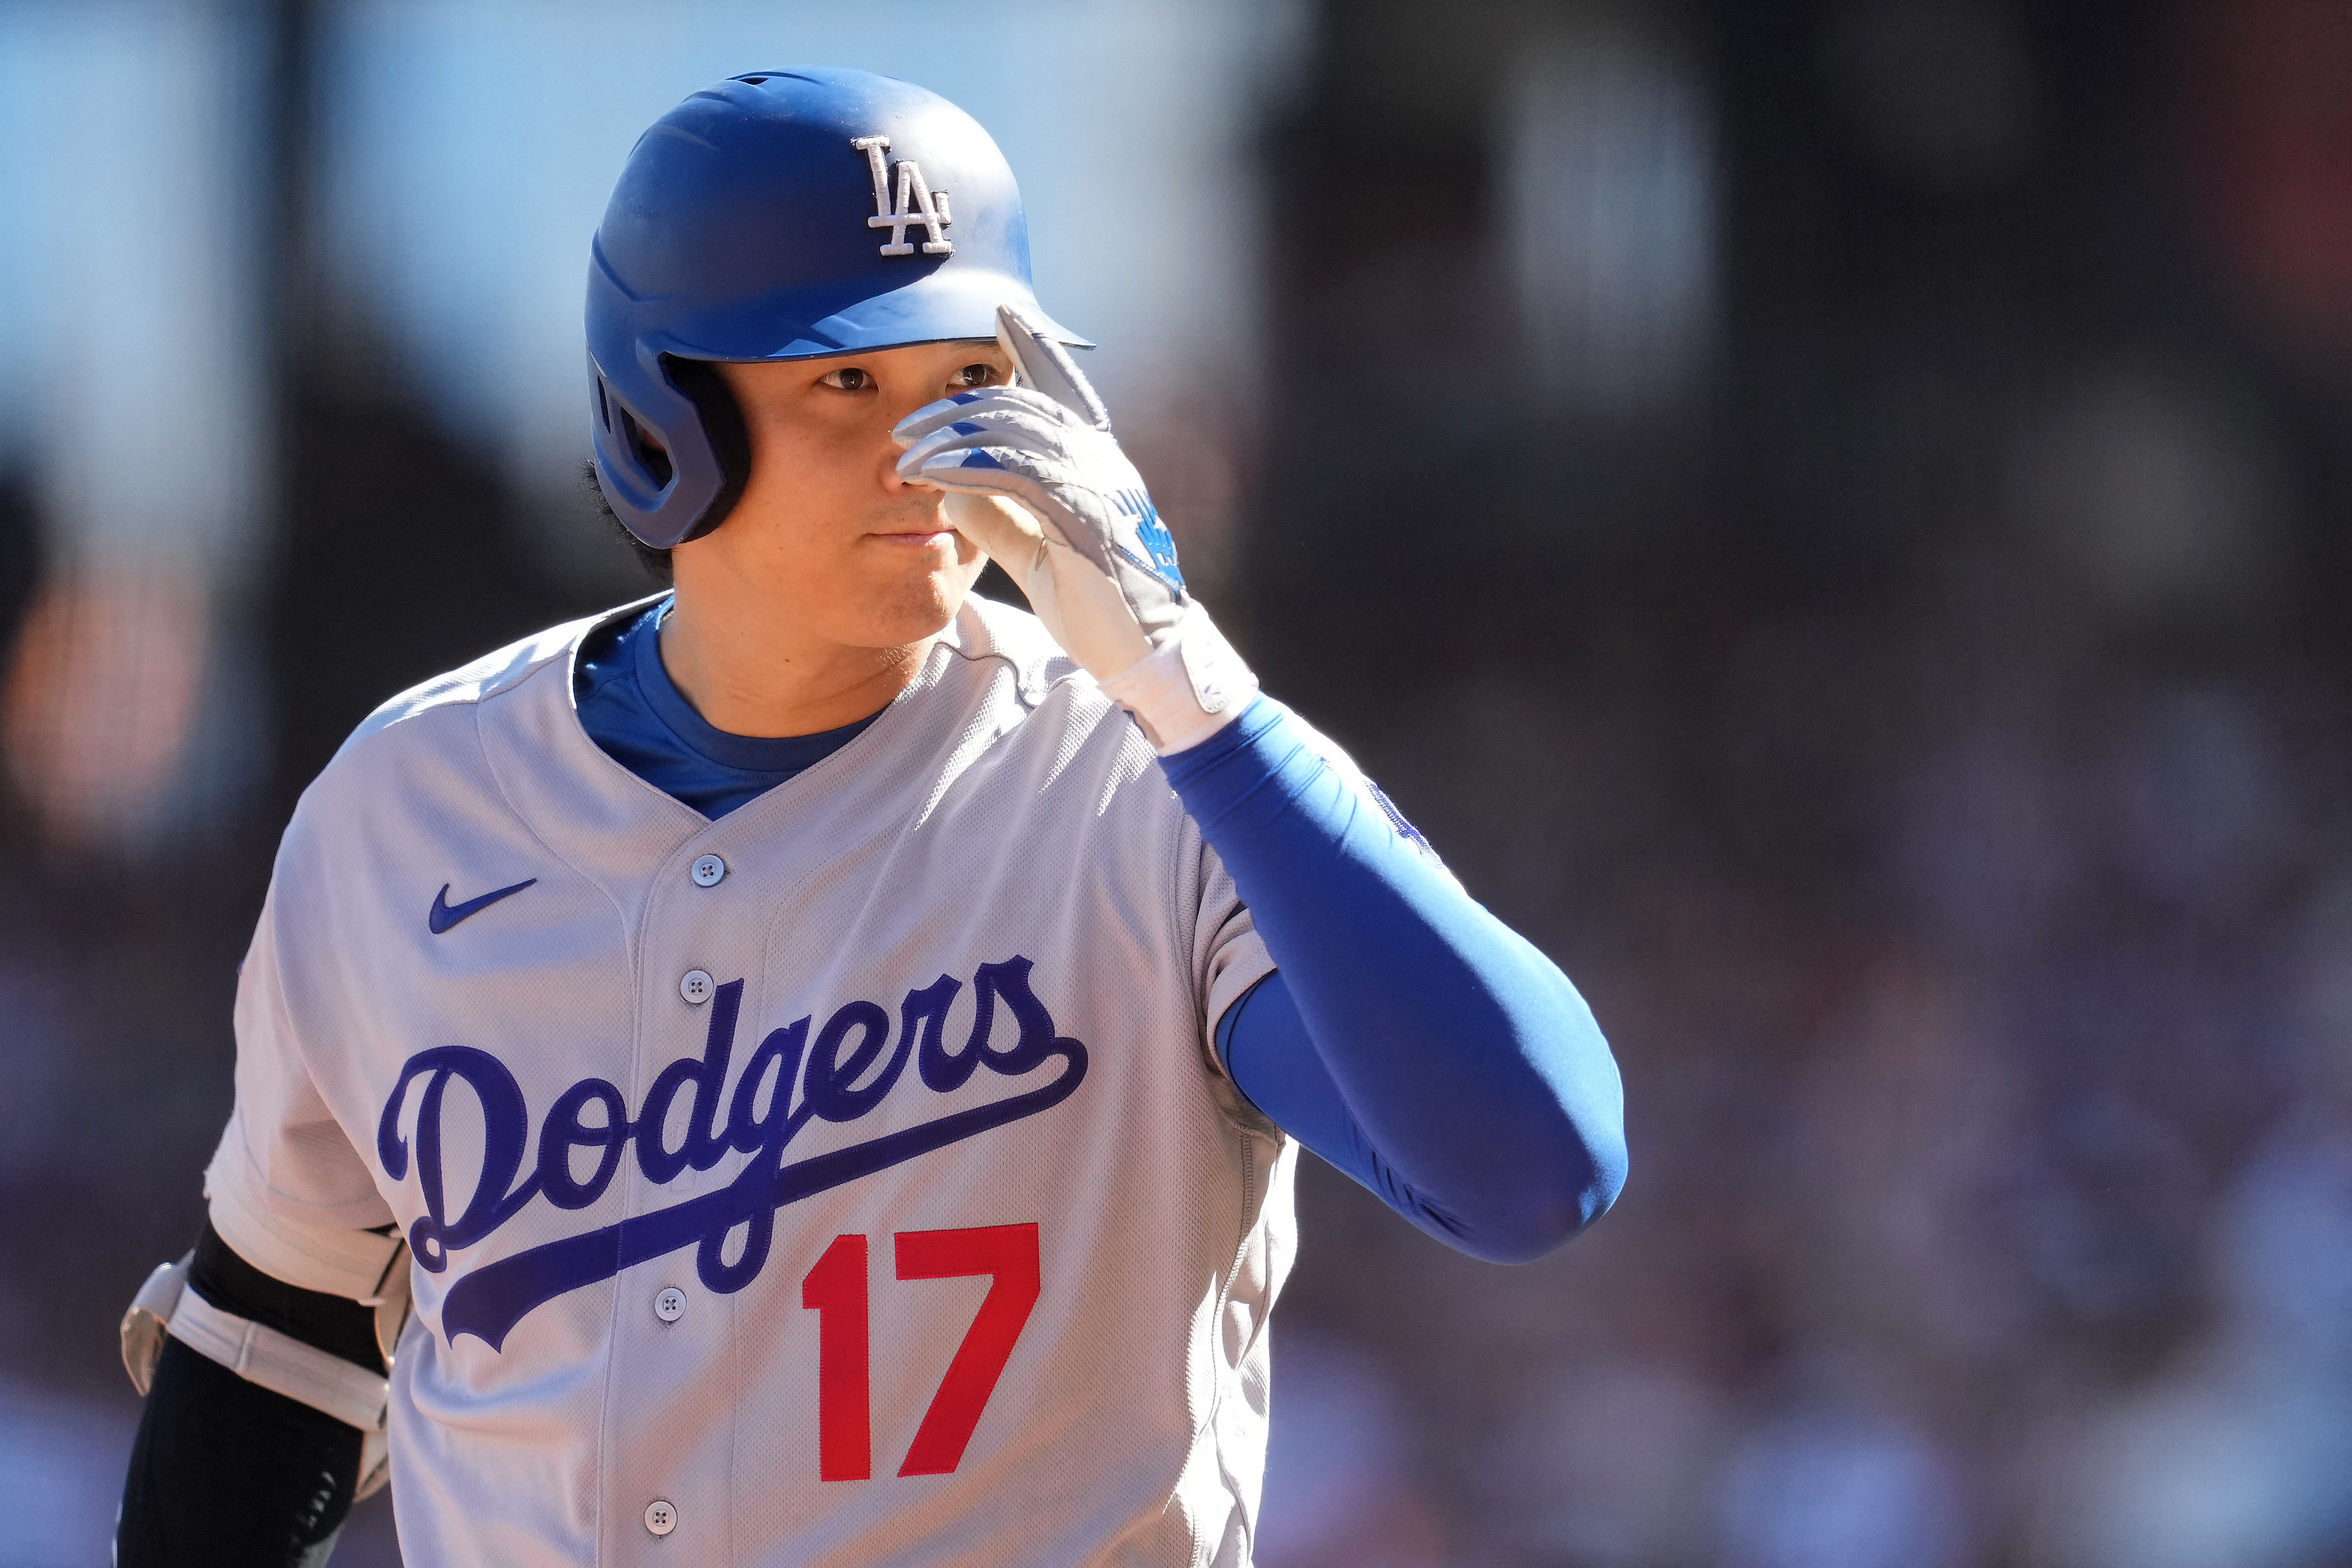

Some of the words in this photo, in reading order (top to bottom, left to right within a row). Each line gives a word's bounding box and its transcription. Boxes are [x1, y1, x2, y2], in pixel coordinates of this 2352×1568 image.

[855, 136, 952, 256] LA
[378, 955, 1088, 1294] Dodgers
[802, 1222, 1041, 1482] 17
